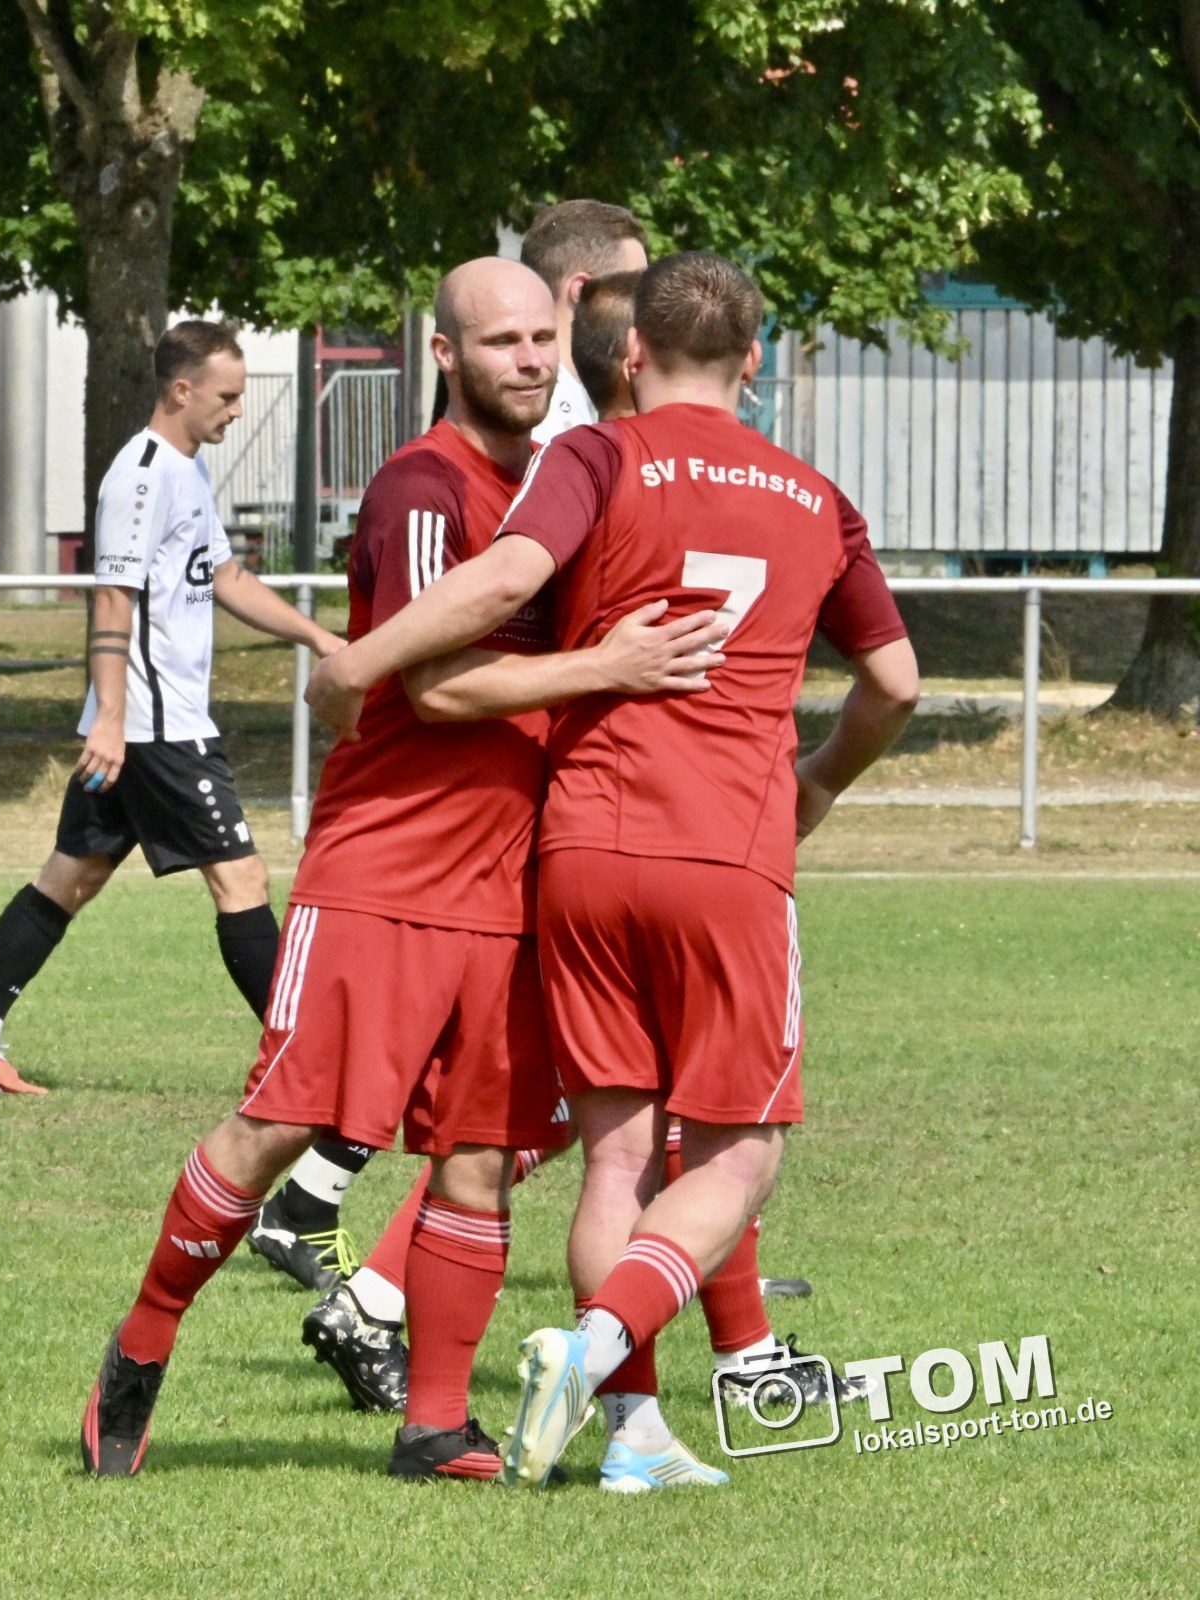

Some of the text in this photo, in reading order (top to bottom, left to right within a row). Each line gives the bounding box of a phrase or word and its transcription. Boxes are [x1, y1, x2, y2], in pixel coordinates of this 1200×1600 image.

[640, 457, 823, 515] SV Fuchstal
[681, 550, 767, 680] 7
